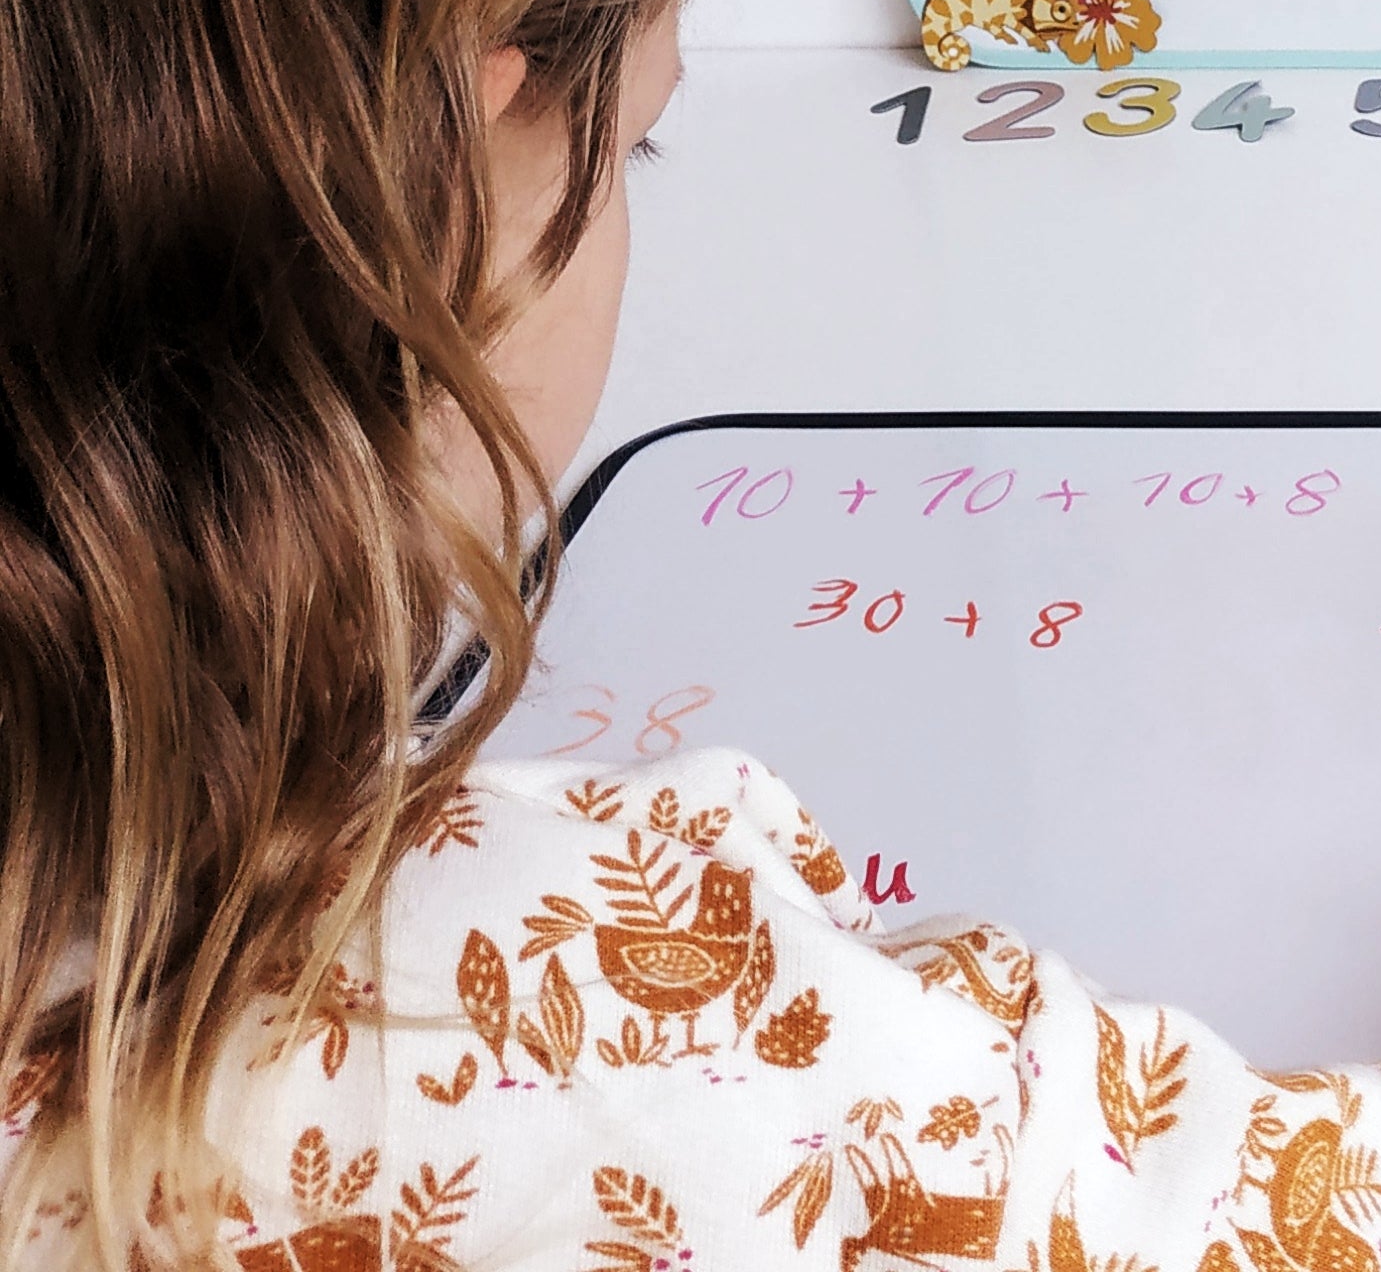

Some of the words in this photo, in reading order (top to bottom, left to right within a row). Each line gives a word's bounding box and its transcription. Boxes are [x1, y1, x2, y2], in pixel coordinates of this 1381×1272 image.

[870, 85, 932, 145] 1
[963, 81, 1065, 142] 2
[1084, 77, 1182, 138] 3
[1191, 79, 1294, 143] 4
[793, 578, 906, 633] 30
[1029, 600, 1083, 649] 8
